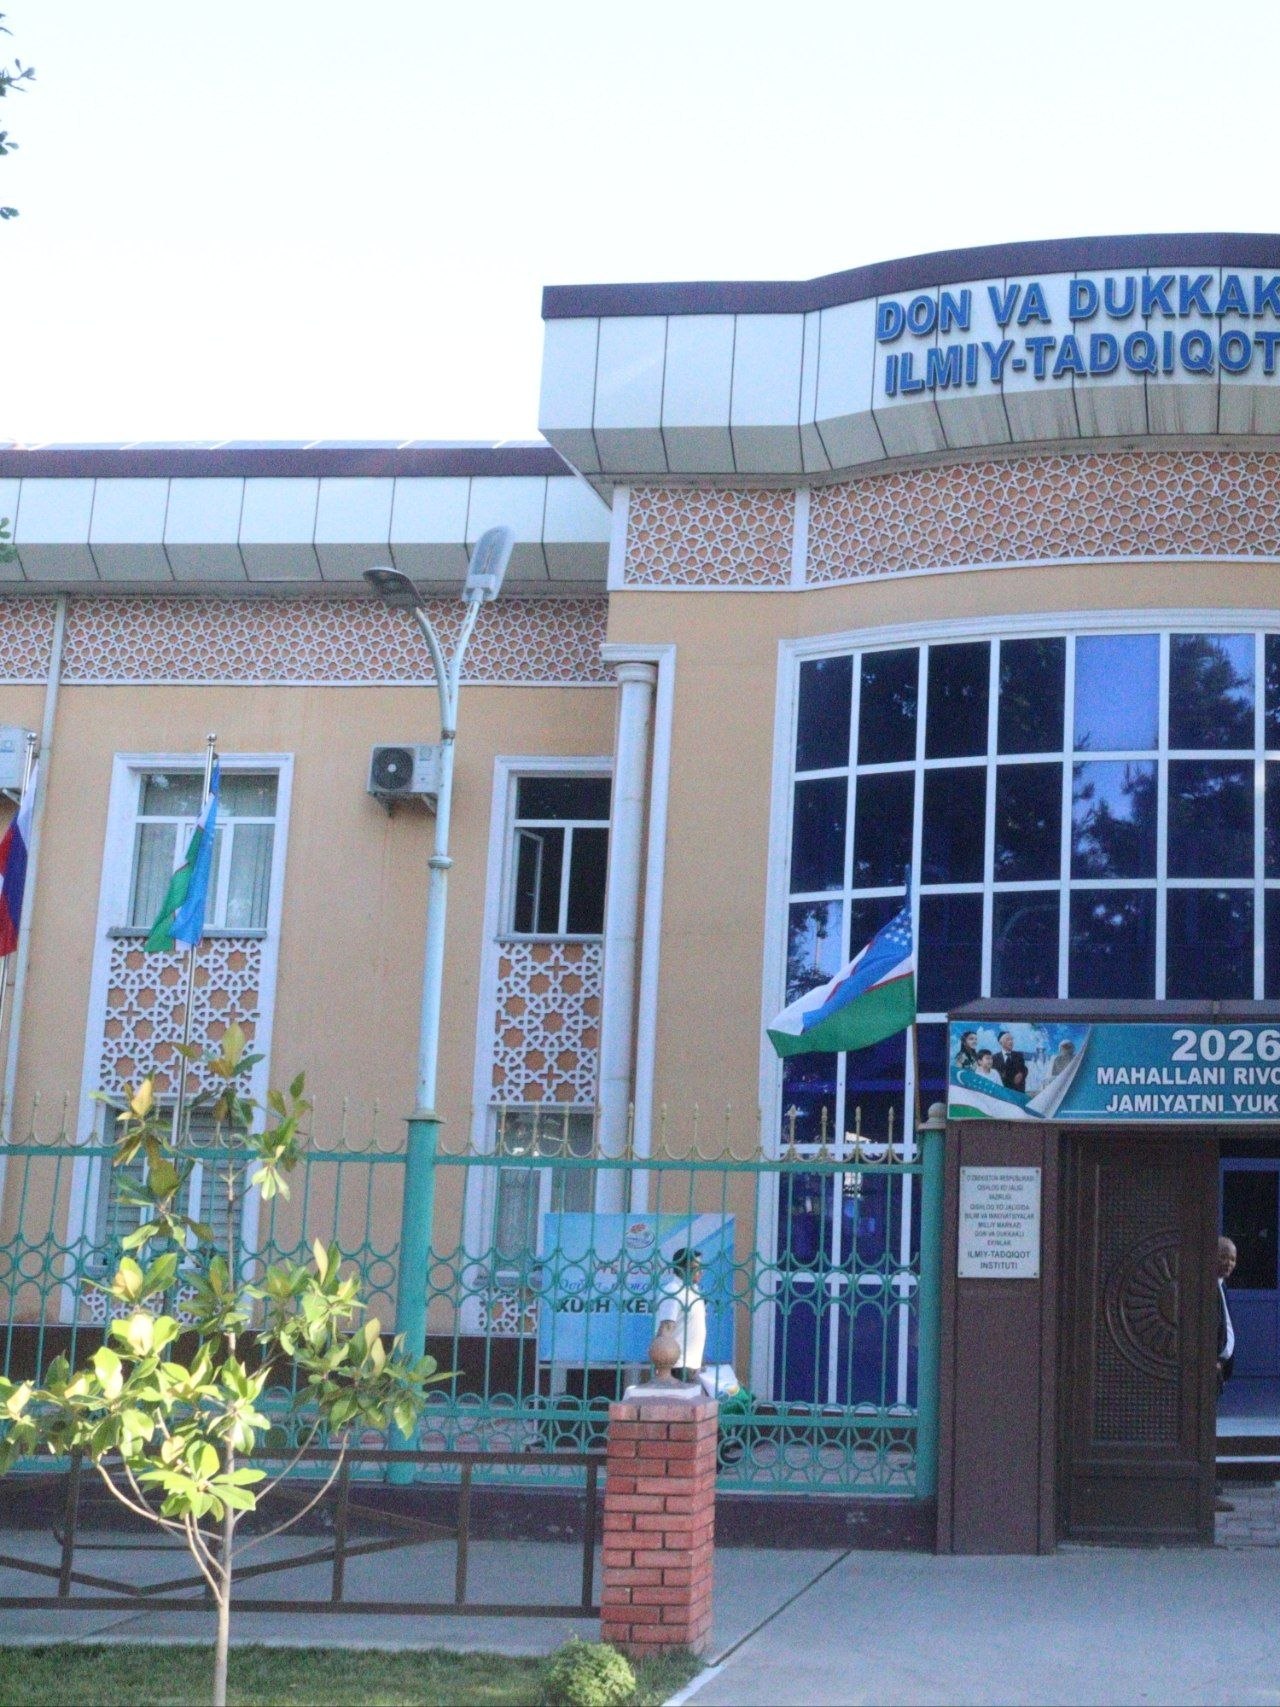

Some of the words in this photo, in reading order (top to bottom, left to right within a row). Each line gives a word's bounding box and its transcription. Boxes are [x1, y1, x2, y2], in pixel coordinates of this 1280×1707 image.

[876, 288, 971, 343] DON
[987, 282, 1051, 326] VA
[1097, 1067, 1226, 1085] MAHALLANI
[1105, 1093, 1225, 1113] JAMIYATNI
[967, 1250, 1031, 1259] ILMIY-TADQIQOT
